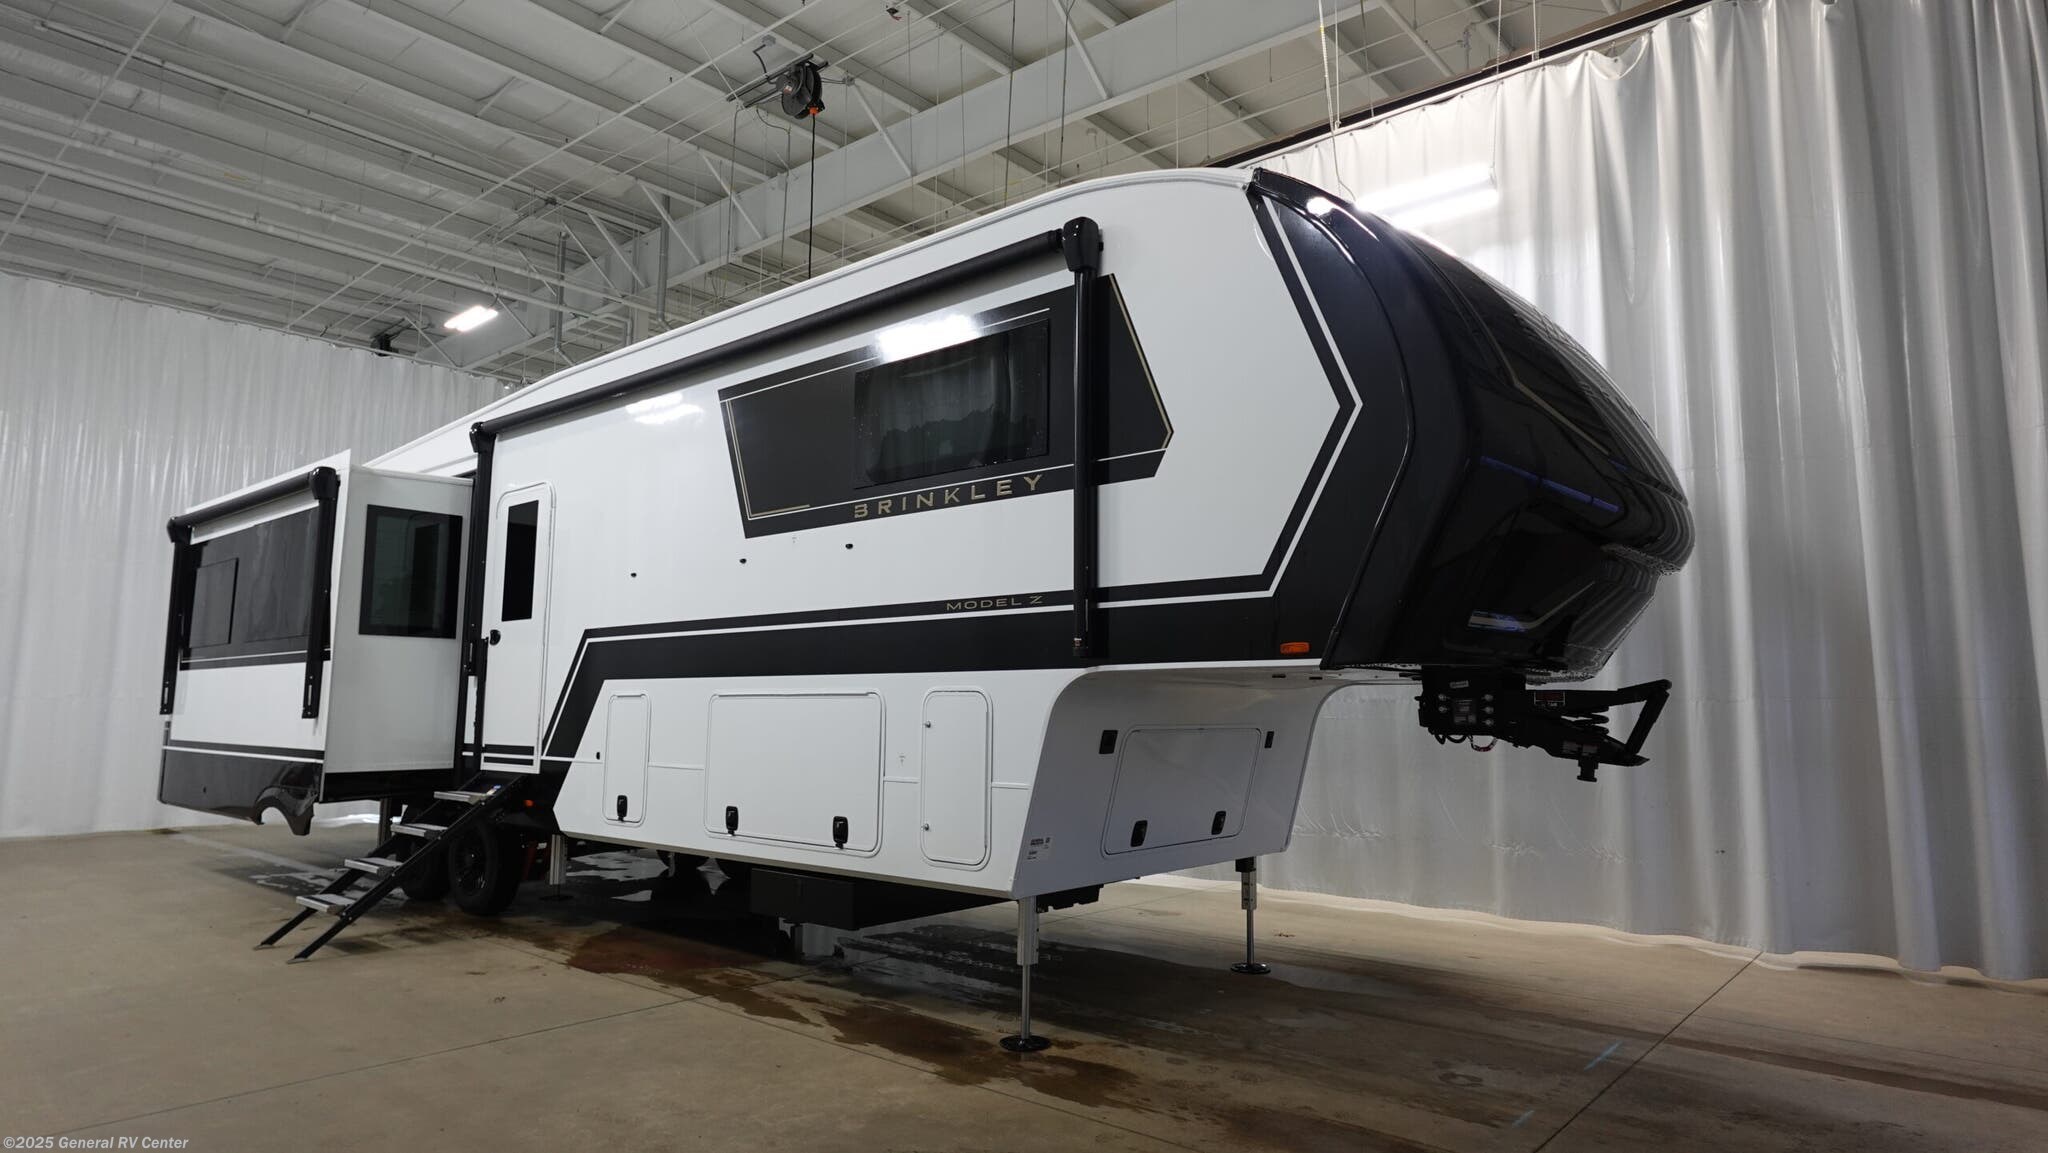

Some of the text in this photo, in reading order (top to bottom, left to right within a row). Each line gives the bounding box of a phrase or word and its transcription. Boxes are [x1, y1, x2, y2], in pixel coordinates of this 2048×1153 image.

[854, 474, 1042, 518] BRINKLEY
[946, 595, 1043, 611] MODEL Z
